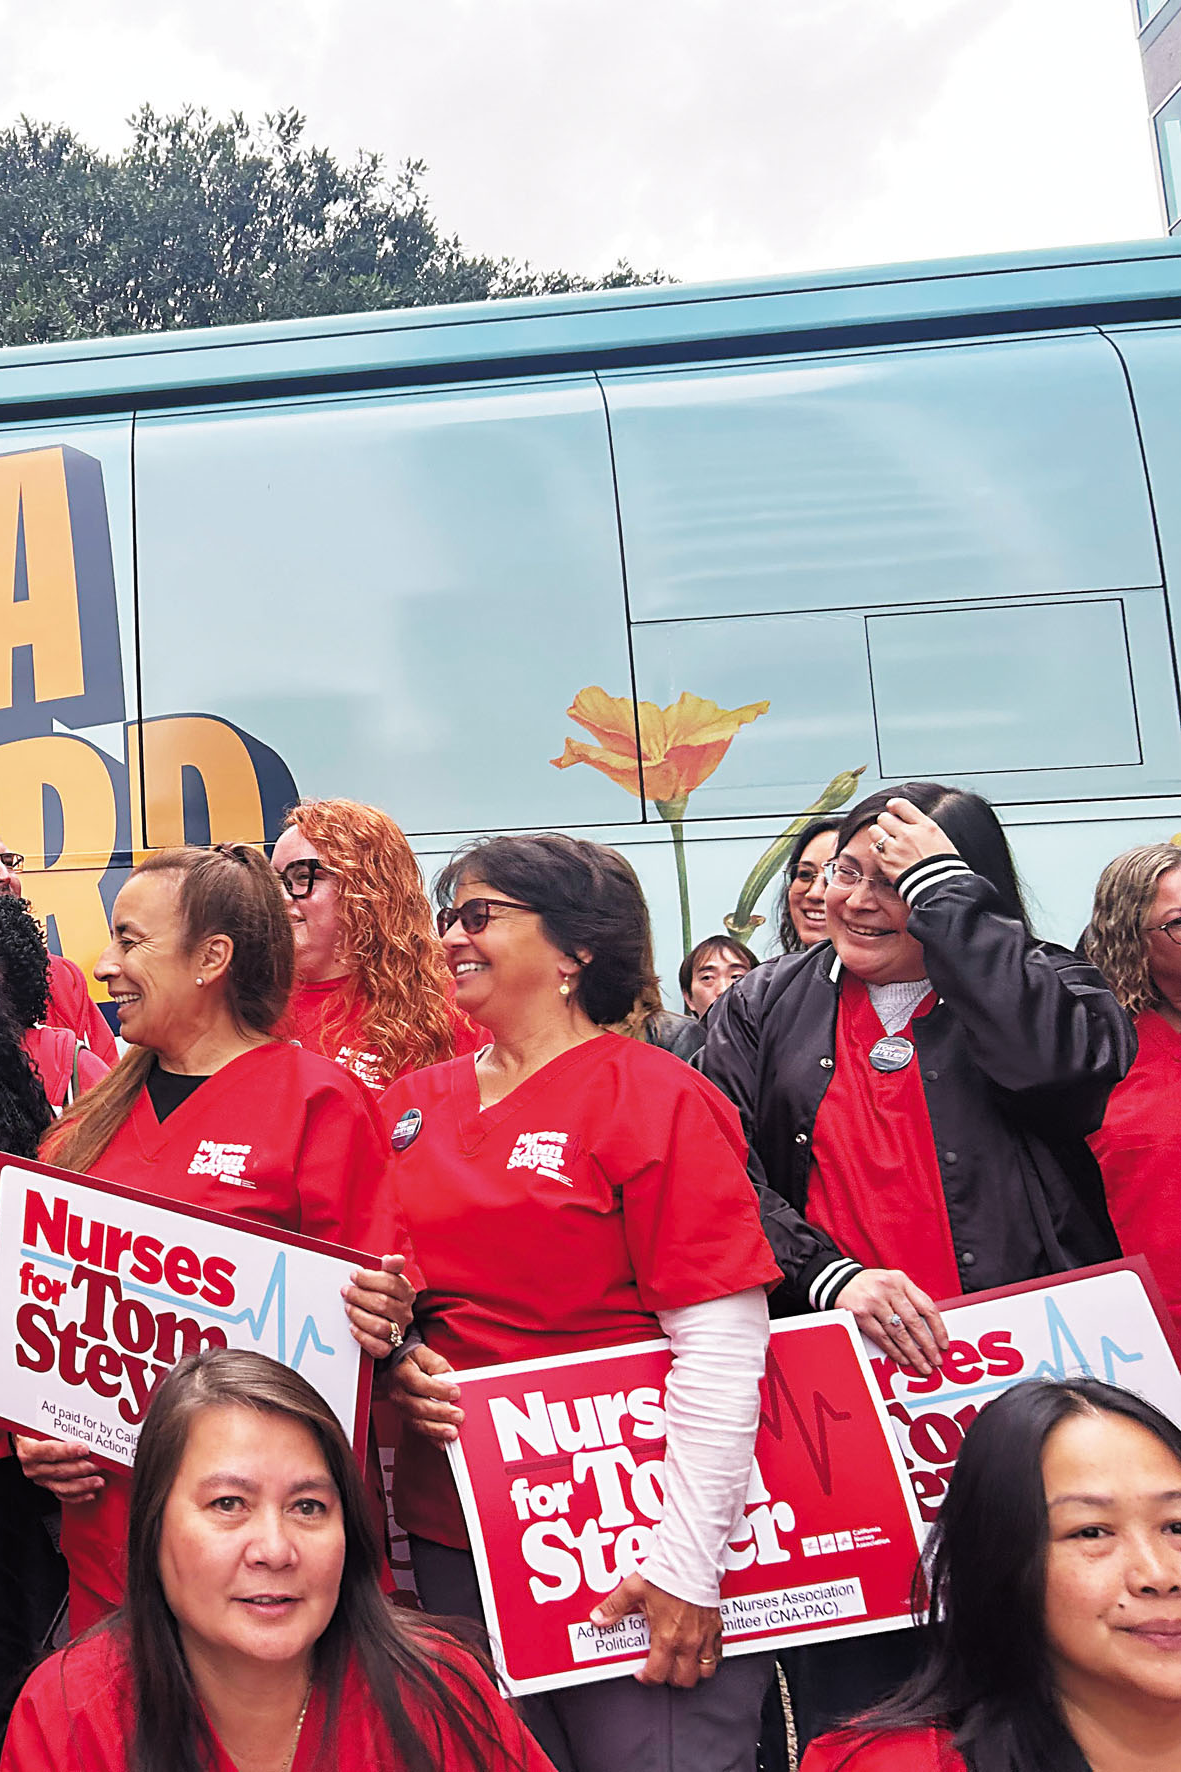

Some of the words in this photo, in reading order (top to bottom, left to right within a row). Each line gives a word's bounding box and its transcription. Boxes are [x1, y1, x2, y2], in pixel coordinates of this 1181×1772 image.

[197, 1140, 252, 1154] Nurses
[208, 1153, 246, 1166] Tom
[516, 1131, 569, 1145] Nurses
[525, 1143, 564, 1158] Tom
[22, 1188, 237, 1308] Nurses
[19, 1261, 67, 1307] for
[70, 1263, 229, 1366] Tom
[15, 1302, 172, 1426] Stey
[869, 1330, 1025, 1401] rses
[41, 1400, 56, 1414] Ad
[58, 1407, 81, 1424] paid
[83, 1415, 98, 1430] for
[99, 1421, 113, 1438] by
[53, 1418, 94, 1443] Political
[95, 1435, 129, 1456] Action
[487, 1386, 667, 1463] Nurs
[509, 1477, 574, 1521] for
[572, 1444, 772, 1529] To
[520, 1500, 796, 1605] Steer
[577, 1624, 595, 1640] Ad
[598, 1618, 626, 1639] paid
[629, 1616, 646, 1632] for
[731, 1597, 779, 1614] Nurses
[781, 1584, 855, 1606] Association
[595, 1633, 645, 1653] Political
[722, 1613, 762, 1631] mittee
[764, 1602, 844, 1627] (CNA-PAC).
